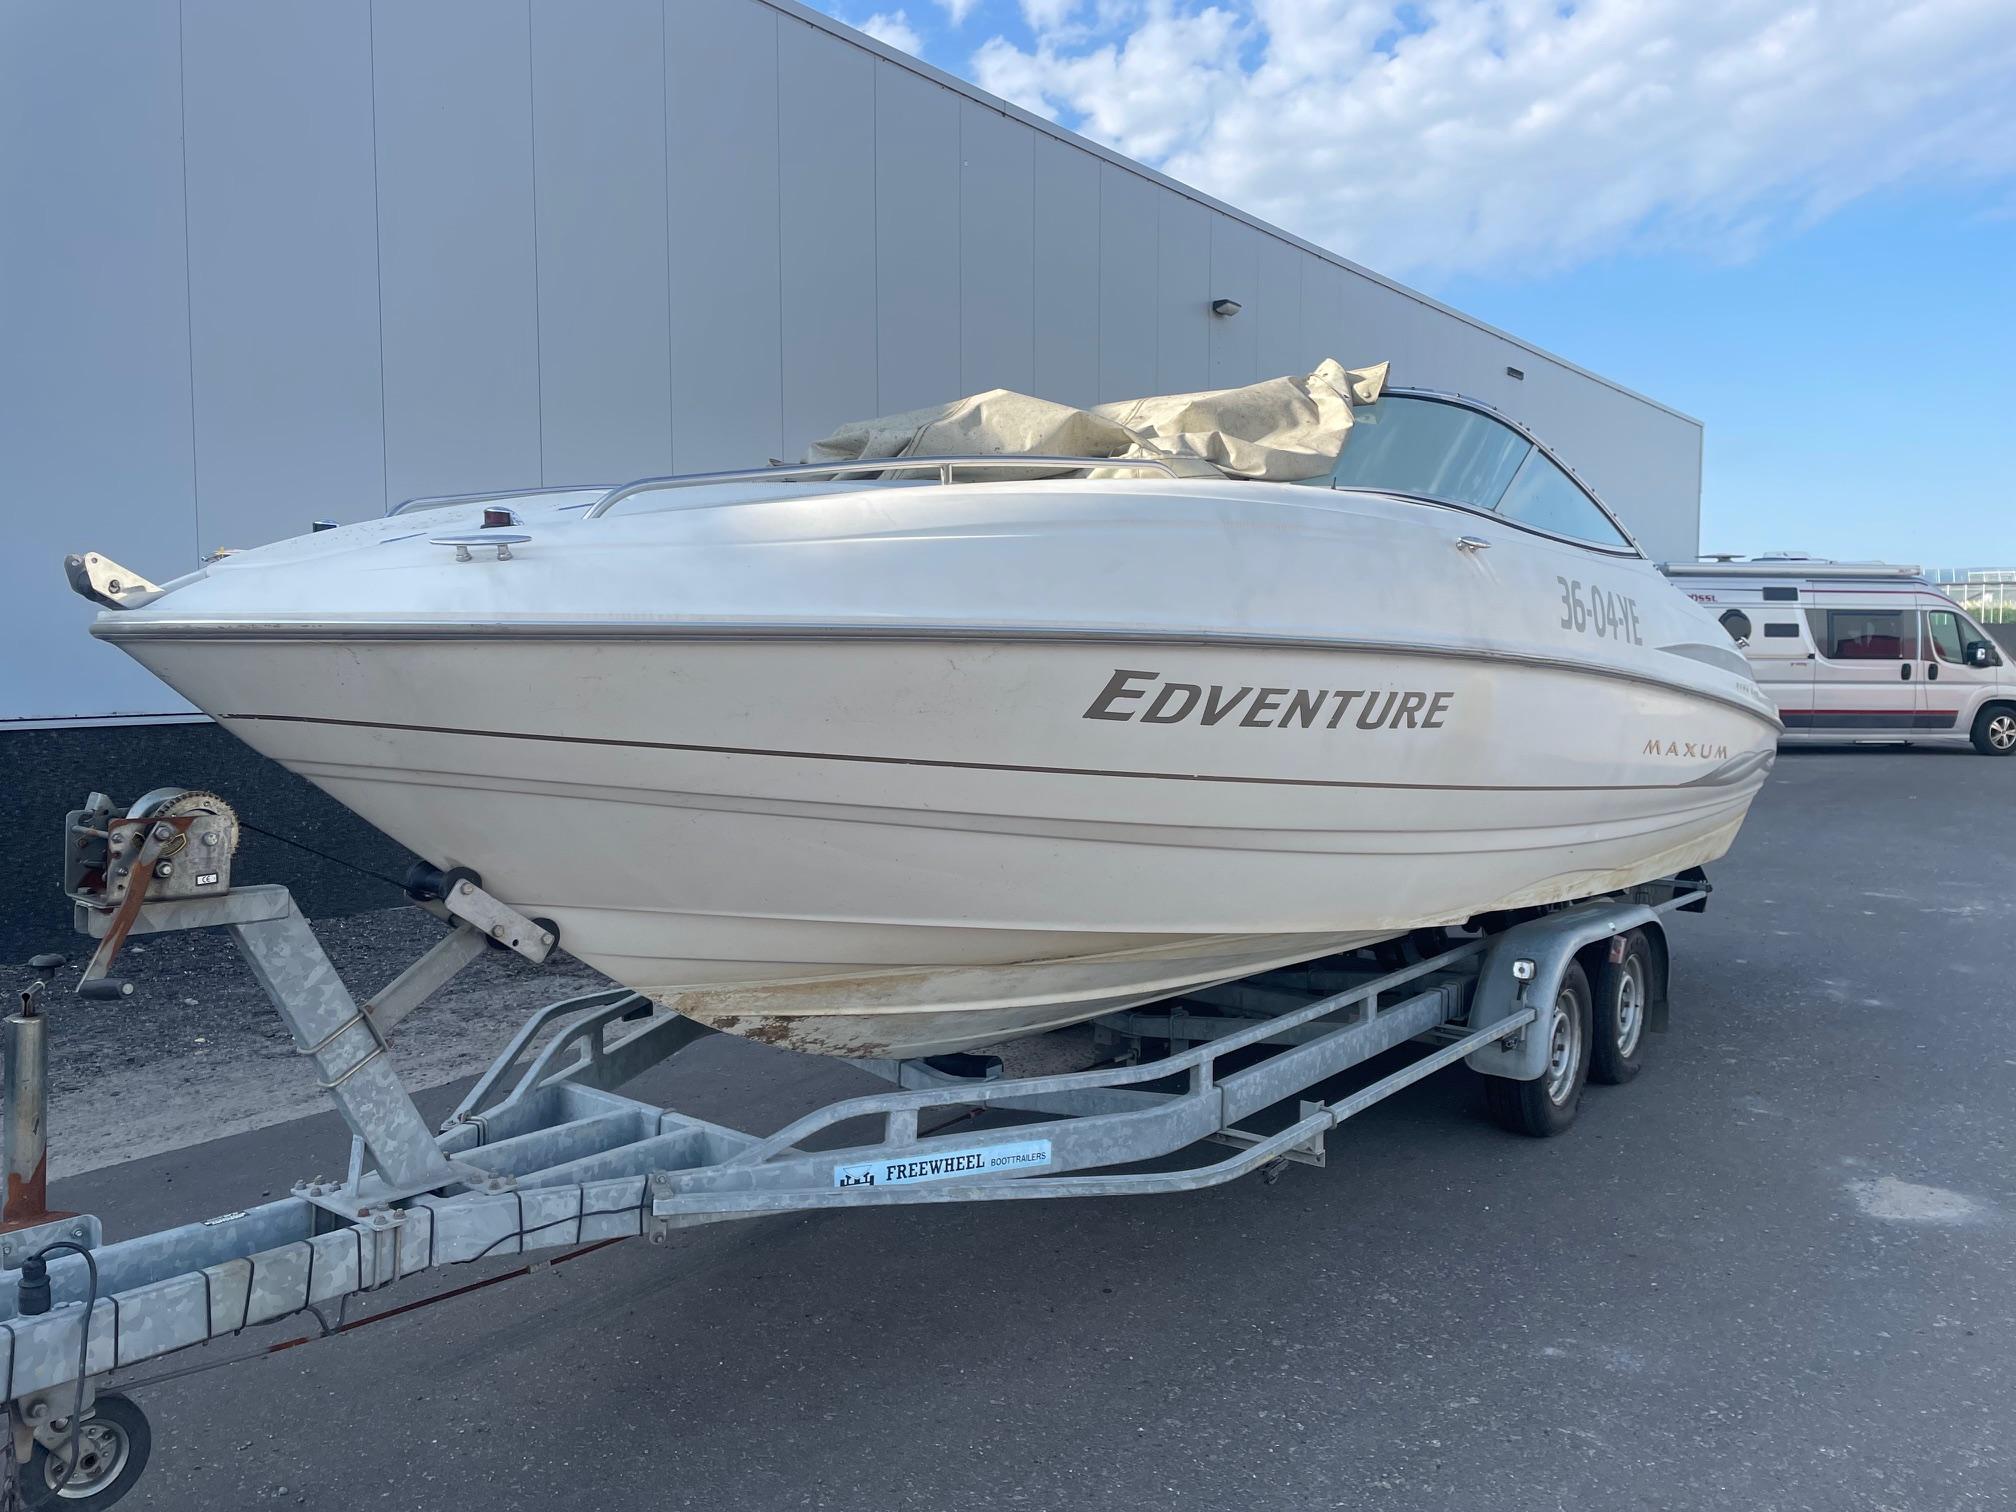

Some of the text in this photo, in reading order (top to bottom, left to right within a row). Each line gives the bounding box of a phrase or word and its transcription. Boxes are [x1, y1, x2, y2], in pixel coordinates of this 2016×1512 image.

[1557, 575, 1643, 646] 36-04-YE
[1082, 669, 1454, 730] EDVENTURE
[1643, 739, 1727, 760] MAXUM
[886, 1151, 1047, 1181] FREEWHEEL BOOTTRAILERS
